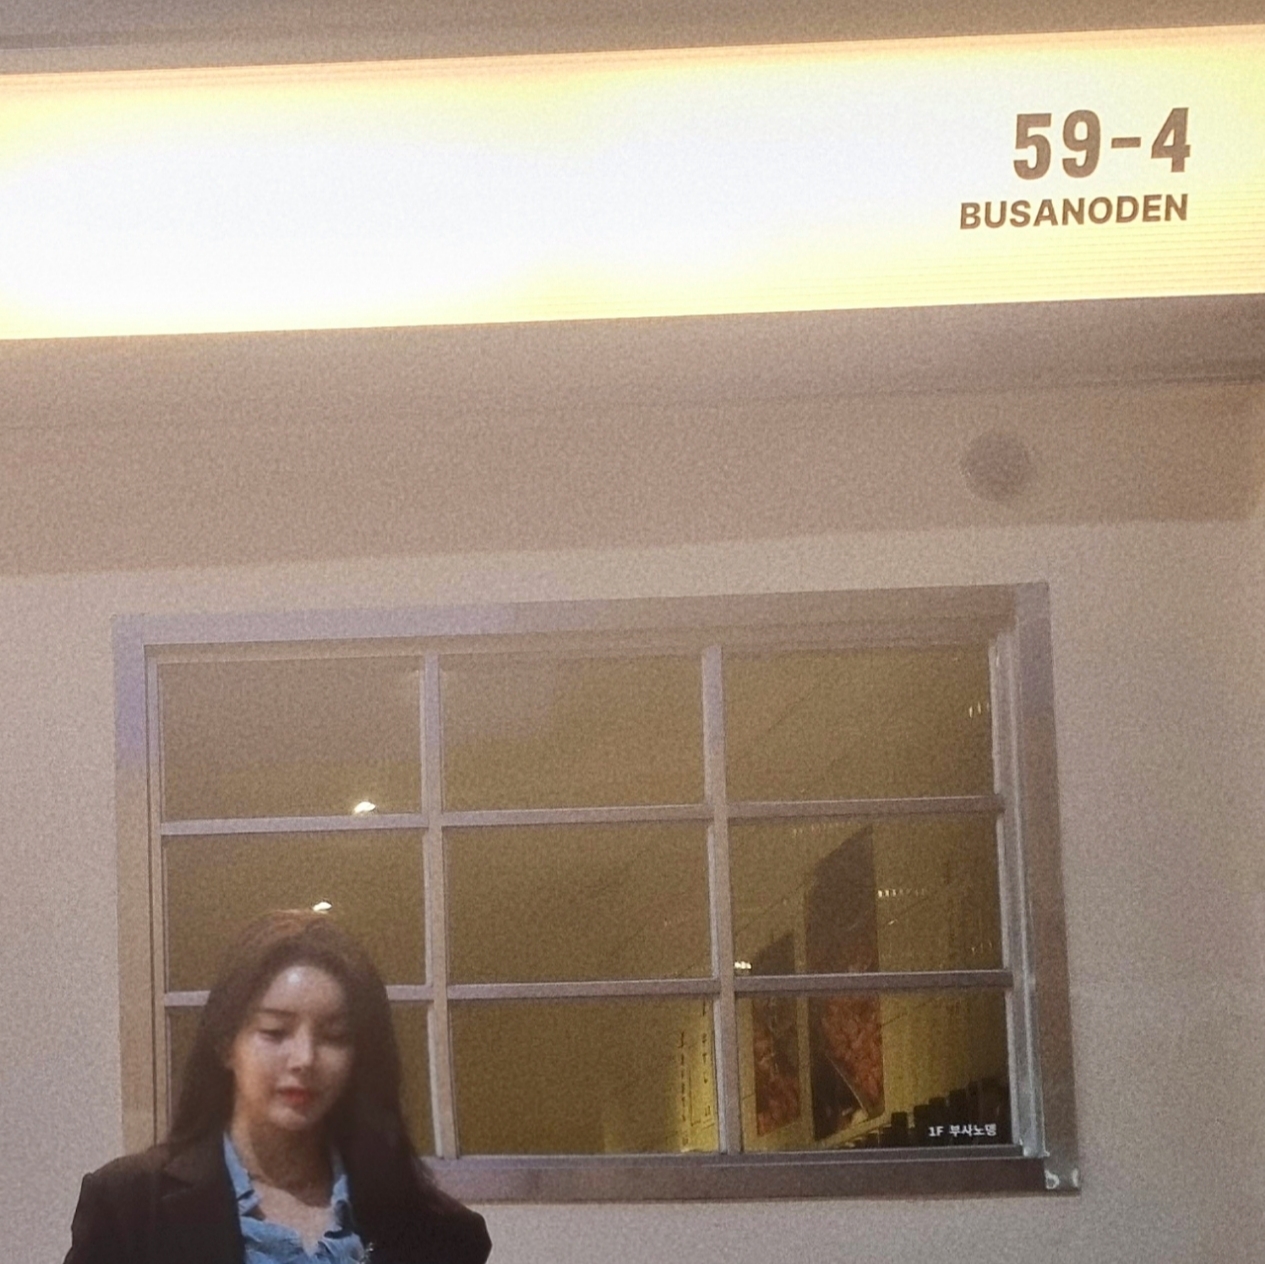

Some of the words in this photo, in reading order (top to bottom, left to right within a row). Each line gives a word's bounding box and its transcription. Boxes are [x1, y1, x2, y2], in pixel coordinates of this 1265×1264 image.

[1013, 107, 1191, 180] 59-4
[959, 193, 1188, 230] BUSANODEN
[928, 1125, 944, 1137] 1F
